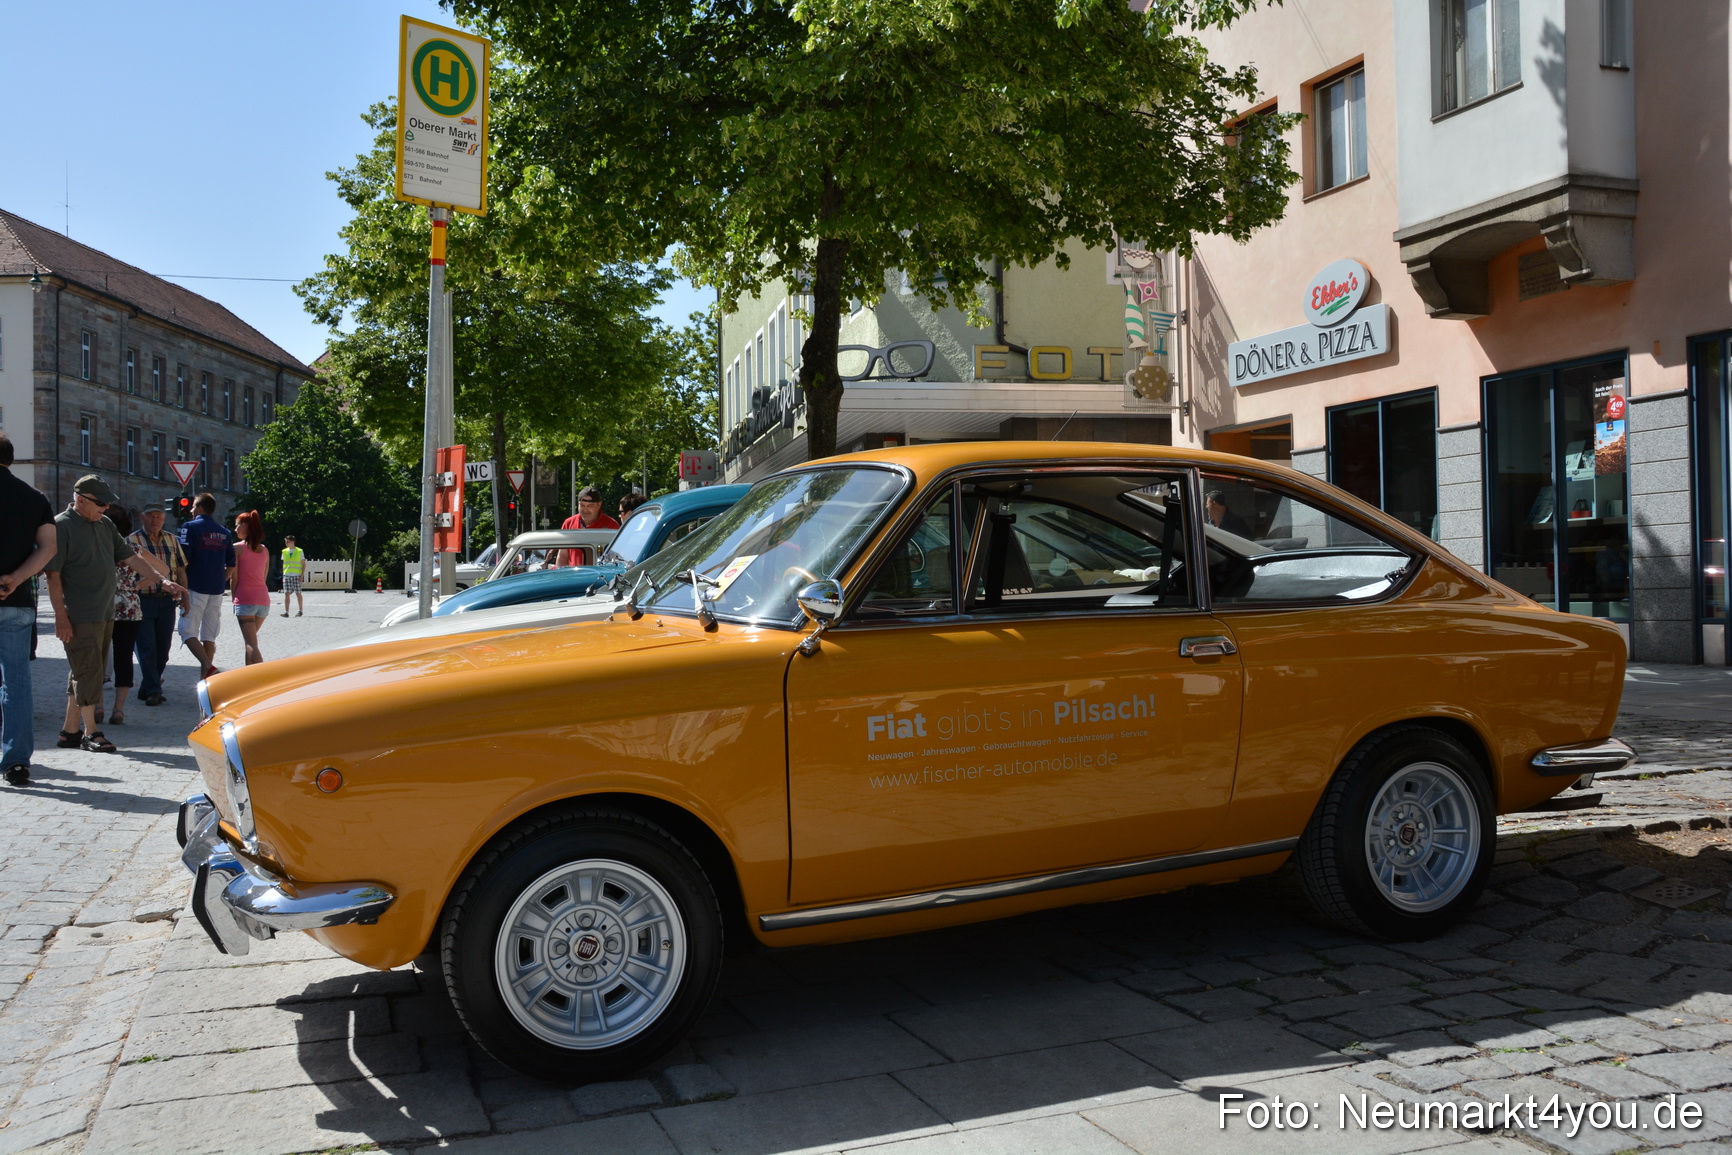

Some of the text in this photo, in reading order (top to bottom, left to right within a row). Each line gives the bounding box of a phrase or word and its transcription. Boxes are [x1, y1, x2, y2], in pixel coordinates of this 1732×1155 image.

[430, 55, 460, 101] H
[409, 117, 445, 134] Oberer
[448, 126, 477, 141] Markt
[426, 150, 449, 160] Bahnhof
[452, 139, 468, 148] swn
[419, 175, 442, 185] Bahnhof
[426, 163, 449, 173] Bahnhof
[1310, 271, 1358, 310] Ekber's
[1235, 321, 1378, 380] DÖNER & PIZZA
[466, 464, 488, 480] WC
[867, 694, 1156, 741] Fiat gibt's in Pilsach!
[867, 729, 1149, 761] Neuwagen Jahreswagen Gebrauchtwagen Nutzfahrzeuge Service
[869, 749, 1118, 789] www.fischer-automobile.de
[578, 941, 596, 956] FIAT
